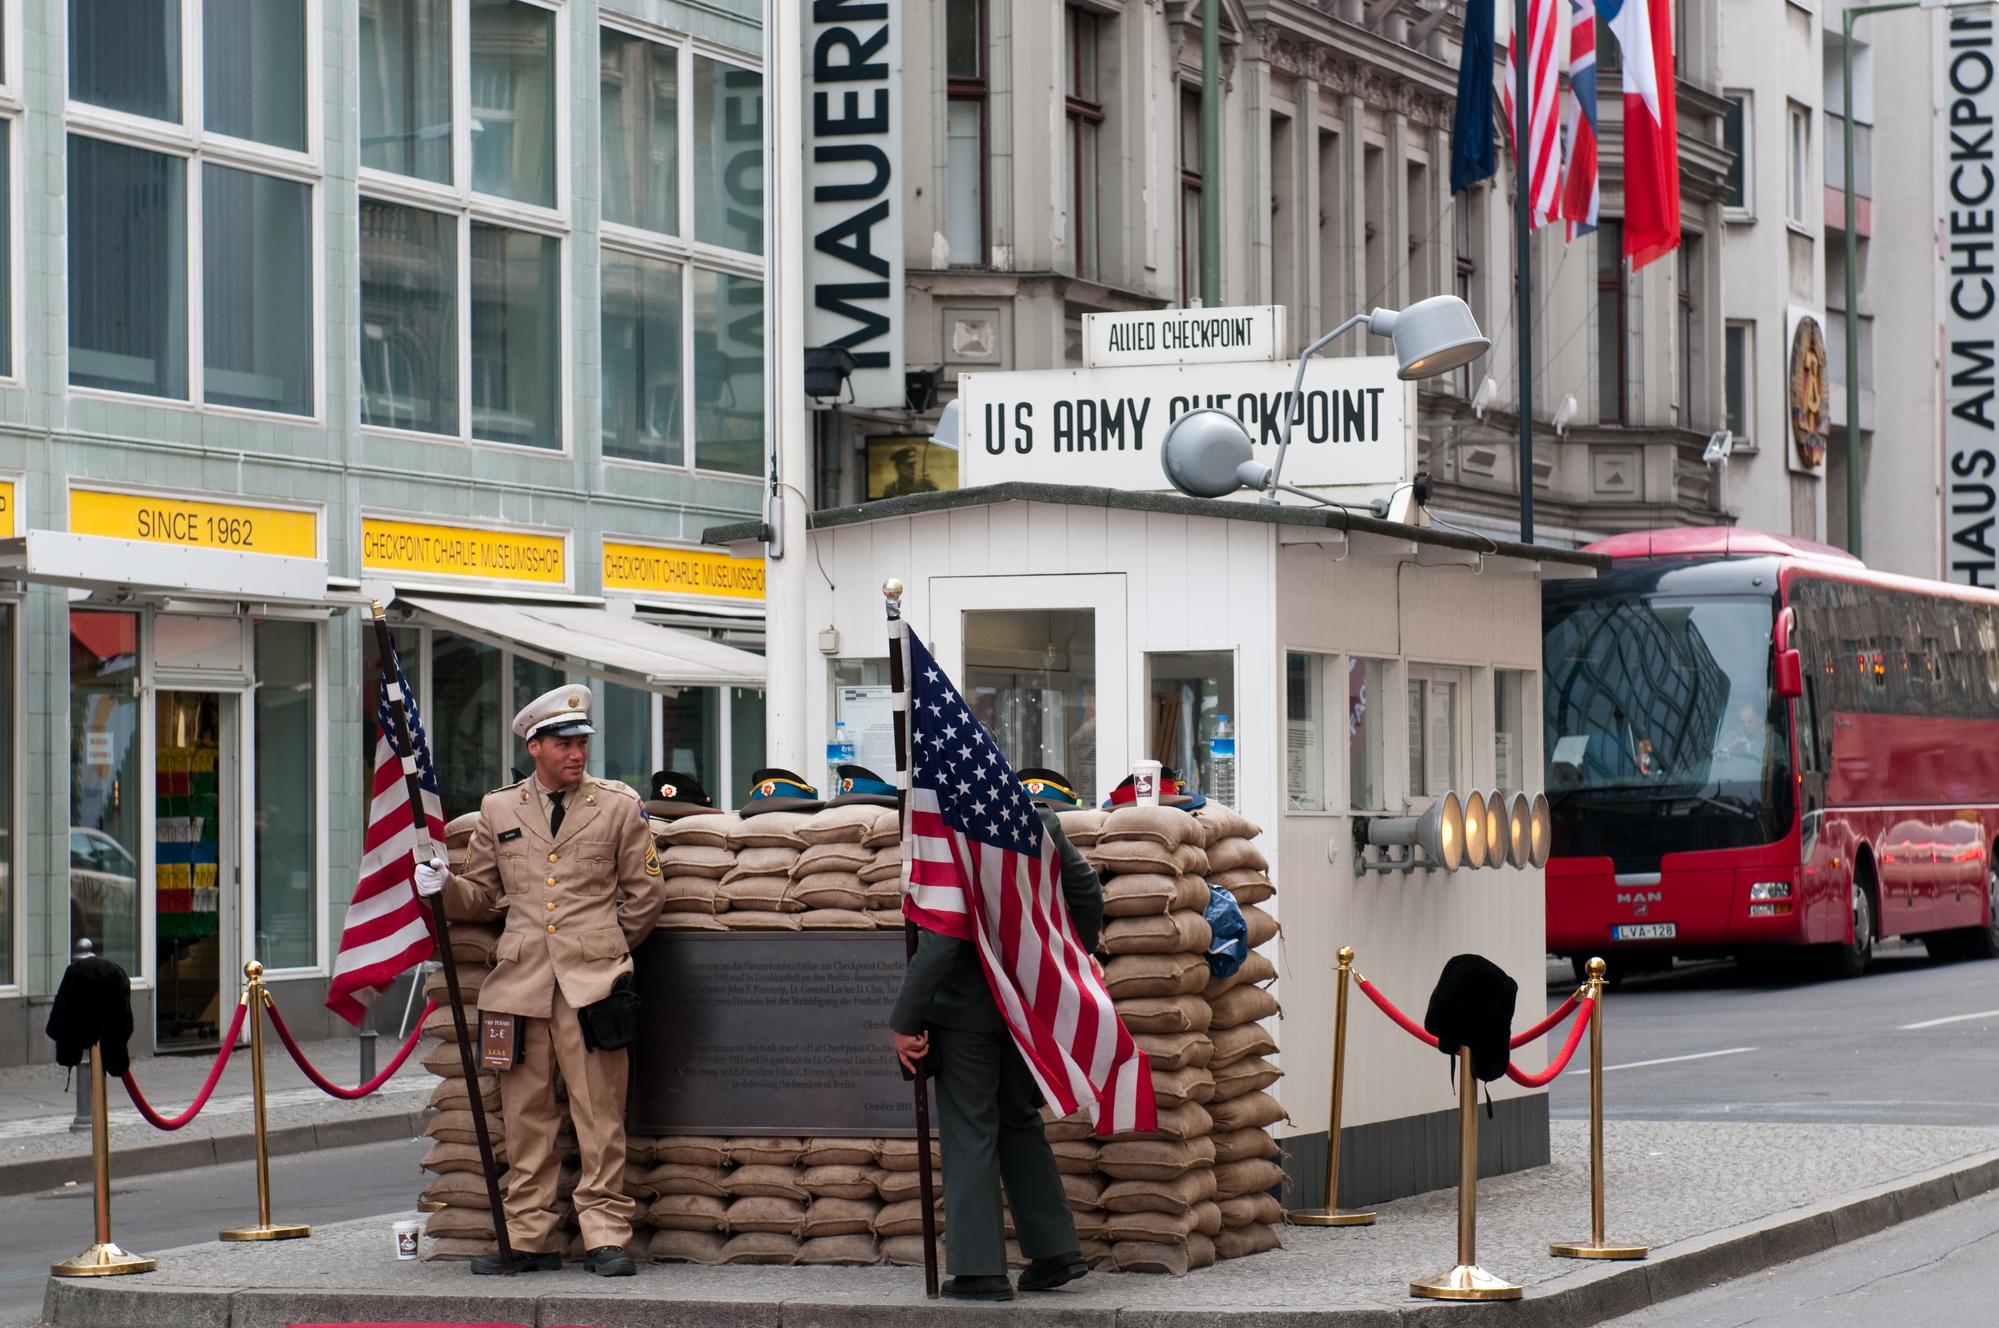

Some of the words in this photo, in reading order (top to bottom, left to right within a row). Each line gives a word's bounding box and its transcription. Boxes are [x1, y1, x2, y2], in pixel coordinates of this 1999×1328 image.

[813, 0, 891, 369] MAUER
[1109, 322, 1156, 352] ALLIED
[1162, 317, 1254, 349] CHECKPOINT
[1950, 339, 1996, 432] AM
[1053, 397, 1151, 452] ARMY
[137, 509, 198, 542] SINCE
[207, 516, 253, 546] 1962
[364, 531, 431, 562] CHECKPOINT
[434, 538, 476, 567] CHARLIE
[480, 543, 559, 573] MUSEUMSSHOP
[605, 554, 661, 583] CHECKPOINT
[663, 559, 699, 586] CHARLIE
[703, 563, 766, 592] MUSEUMSSHO
[1617, 891, 1662, 903] MAN
[1620, 924, 1673, 938] LVA-128
